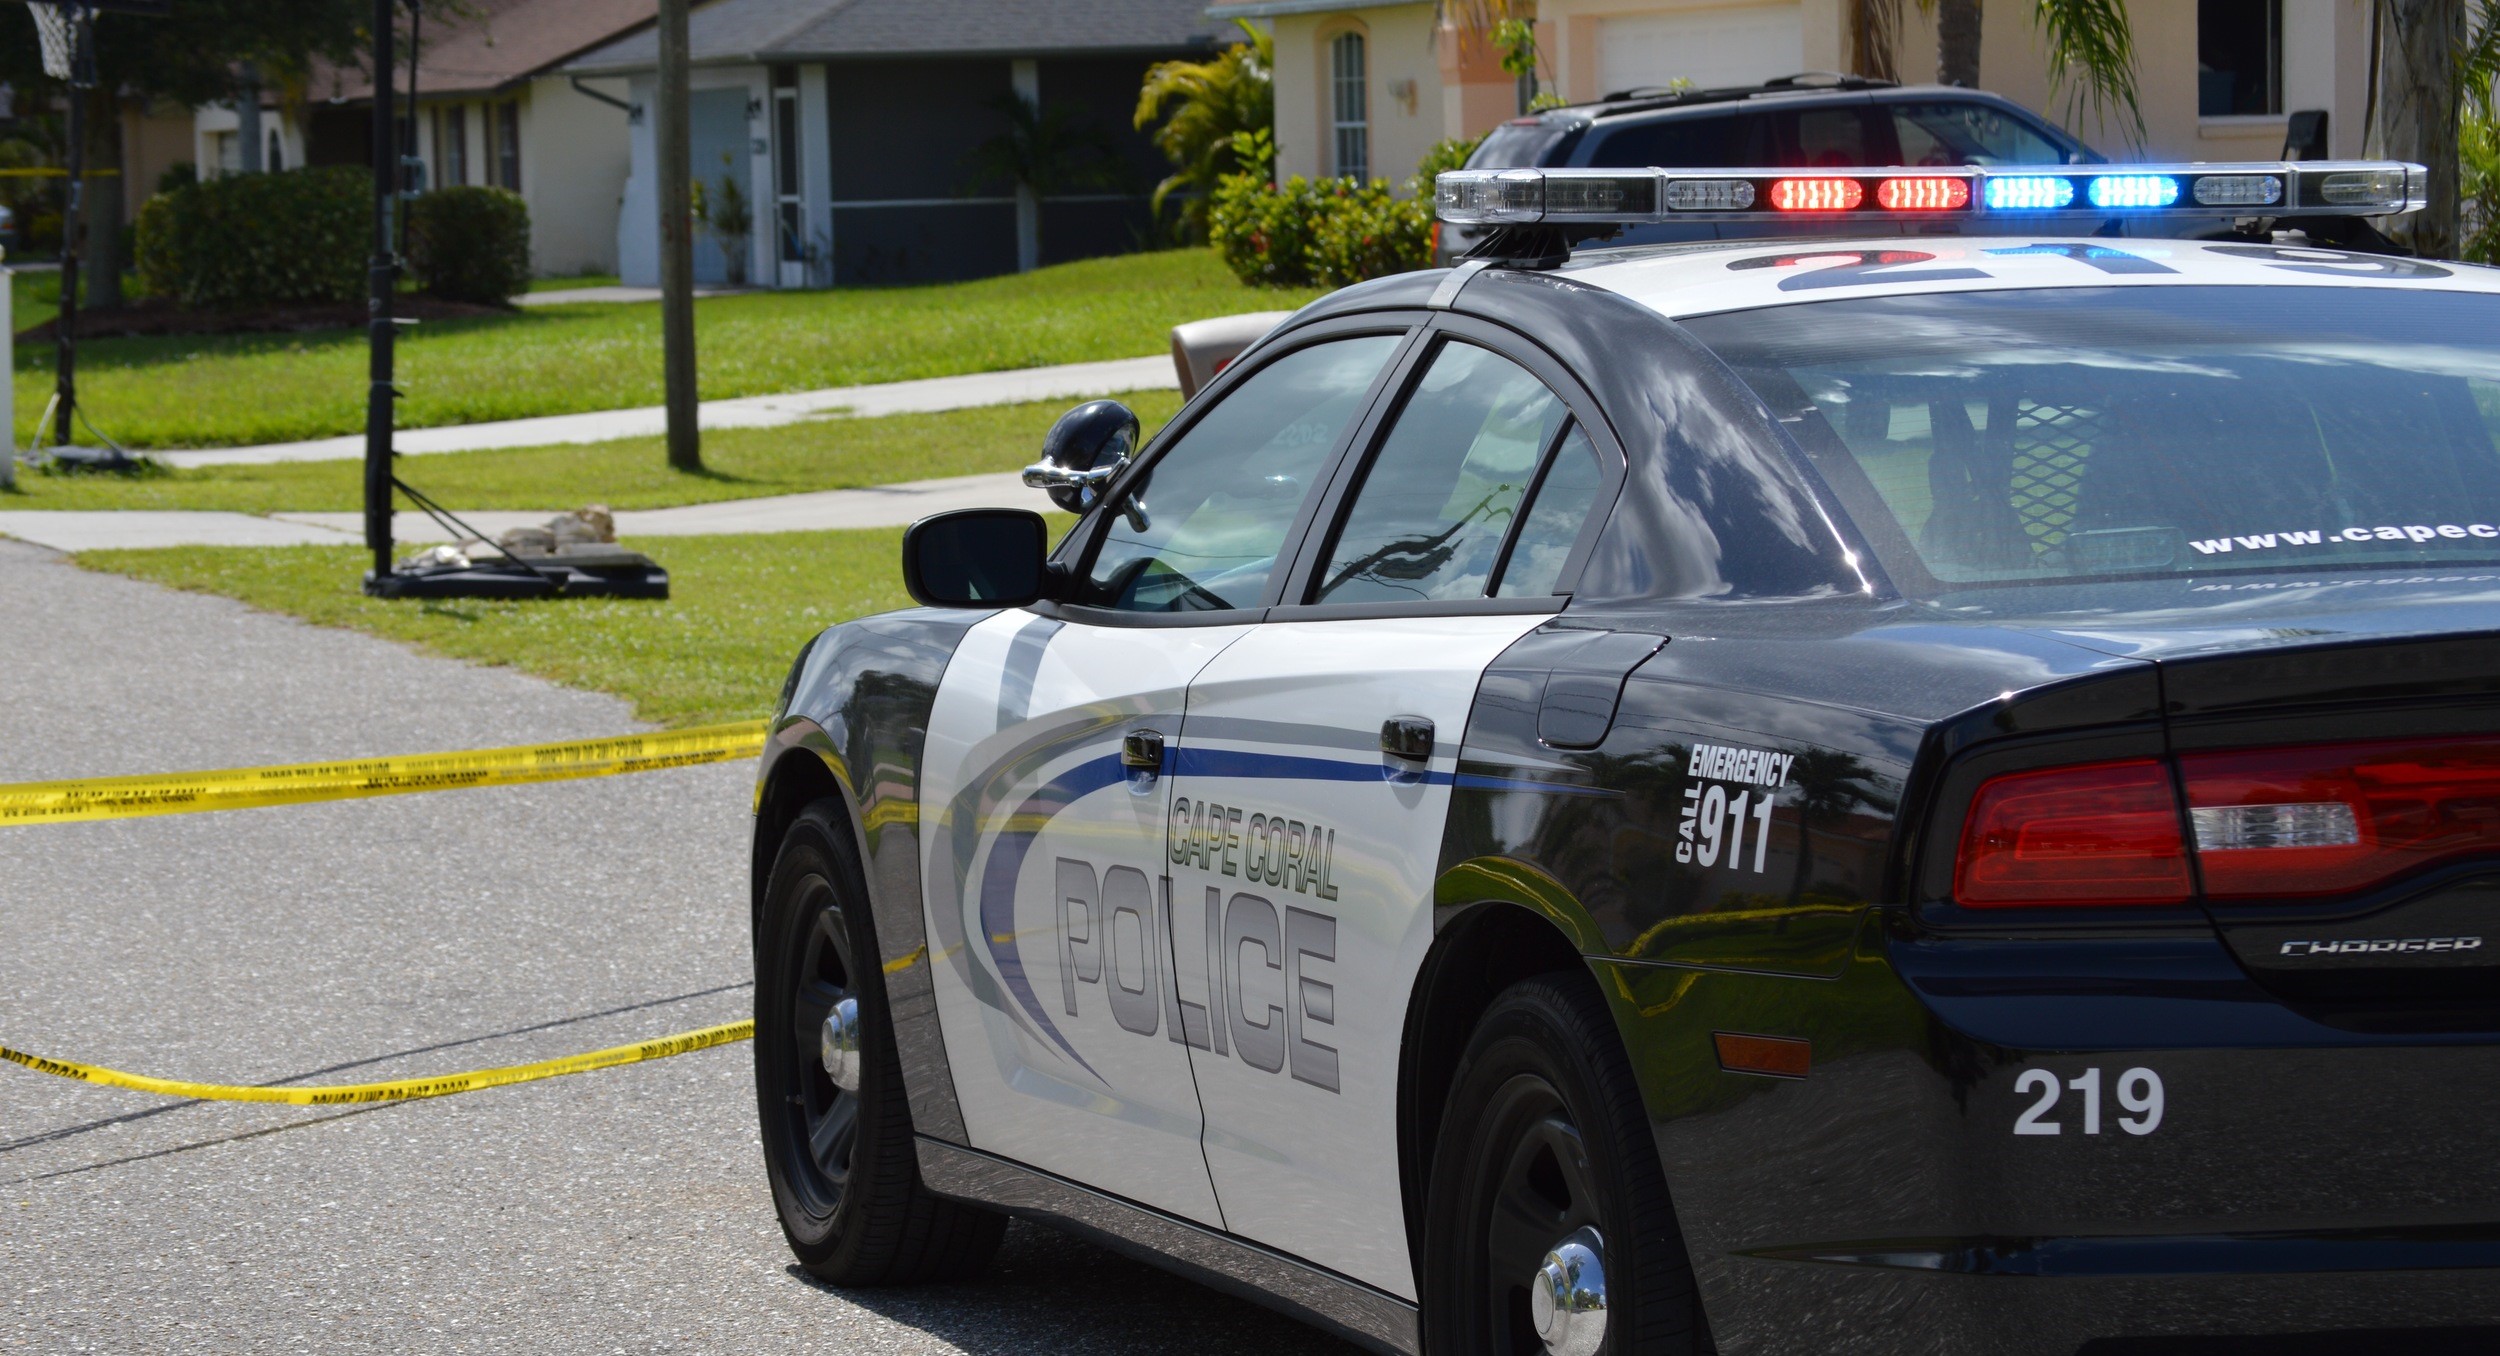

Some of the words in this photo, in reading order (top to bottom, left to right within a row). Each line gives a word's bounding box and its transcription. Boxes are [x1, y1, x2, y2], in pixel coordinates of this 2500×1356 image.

[1726, 243, 2454, 291] 219
[2189, 524, 2500, 555] www.capec
[1687, 743, 1795, 788] EMERGENCY
[1168, 797, 1242, 878] CAPE
[1245, 812, 1339, 902] CORAL
[1675, 781, 1703, 864] CALL
[1697, 784, 1775, 874] 911
[1055, 856, 1341, 1095] POLICE
[2280, 936, 2482, 956] CHARGER
[2013, 1066, 2165, 1135] 219
